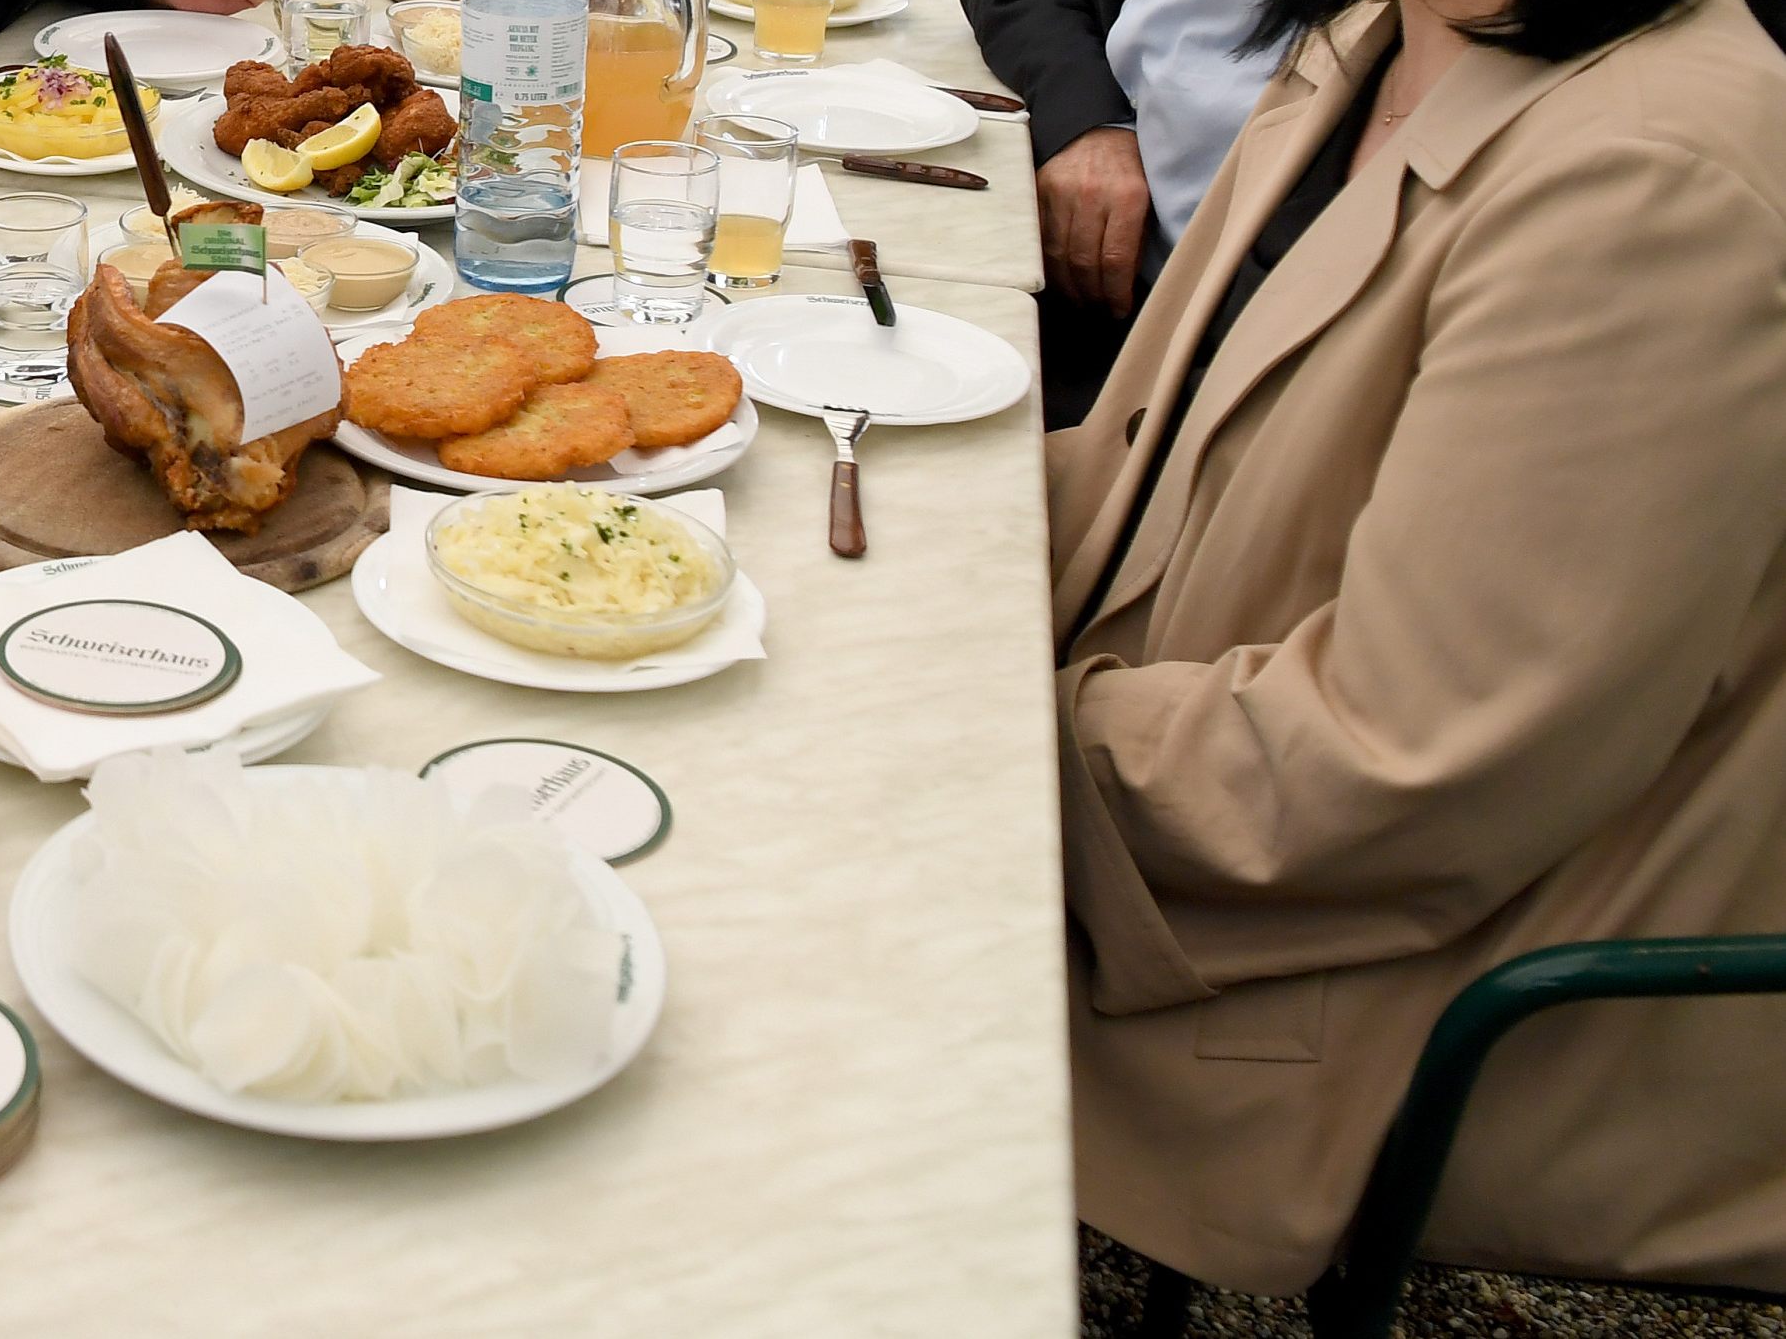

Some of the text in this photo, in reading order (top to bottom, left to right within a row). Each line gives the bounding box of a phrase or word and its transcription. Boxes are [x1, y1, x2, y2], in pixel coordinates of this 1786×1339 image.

[530, 92, 548, 101] LITER
[190, 244, 262, 258] Schweizerhaus
[211, 255, 242, 264] Stelze
[26, 627, 209, 670] Schweizerhaus
